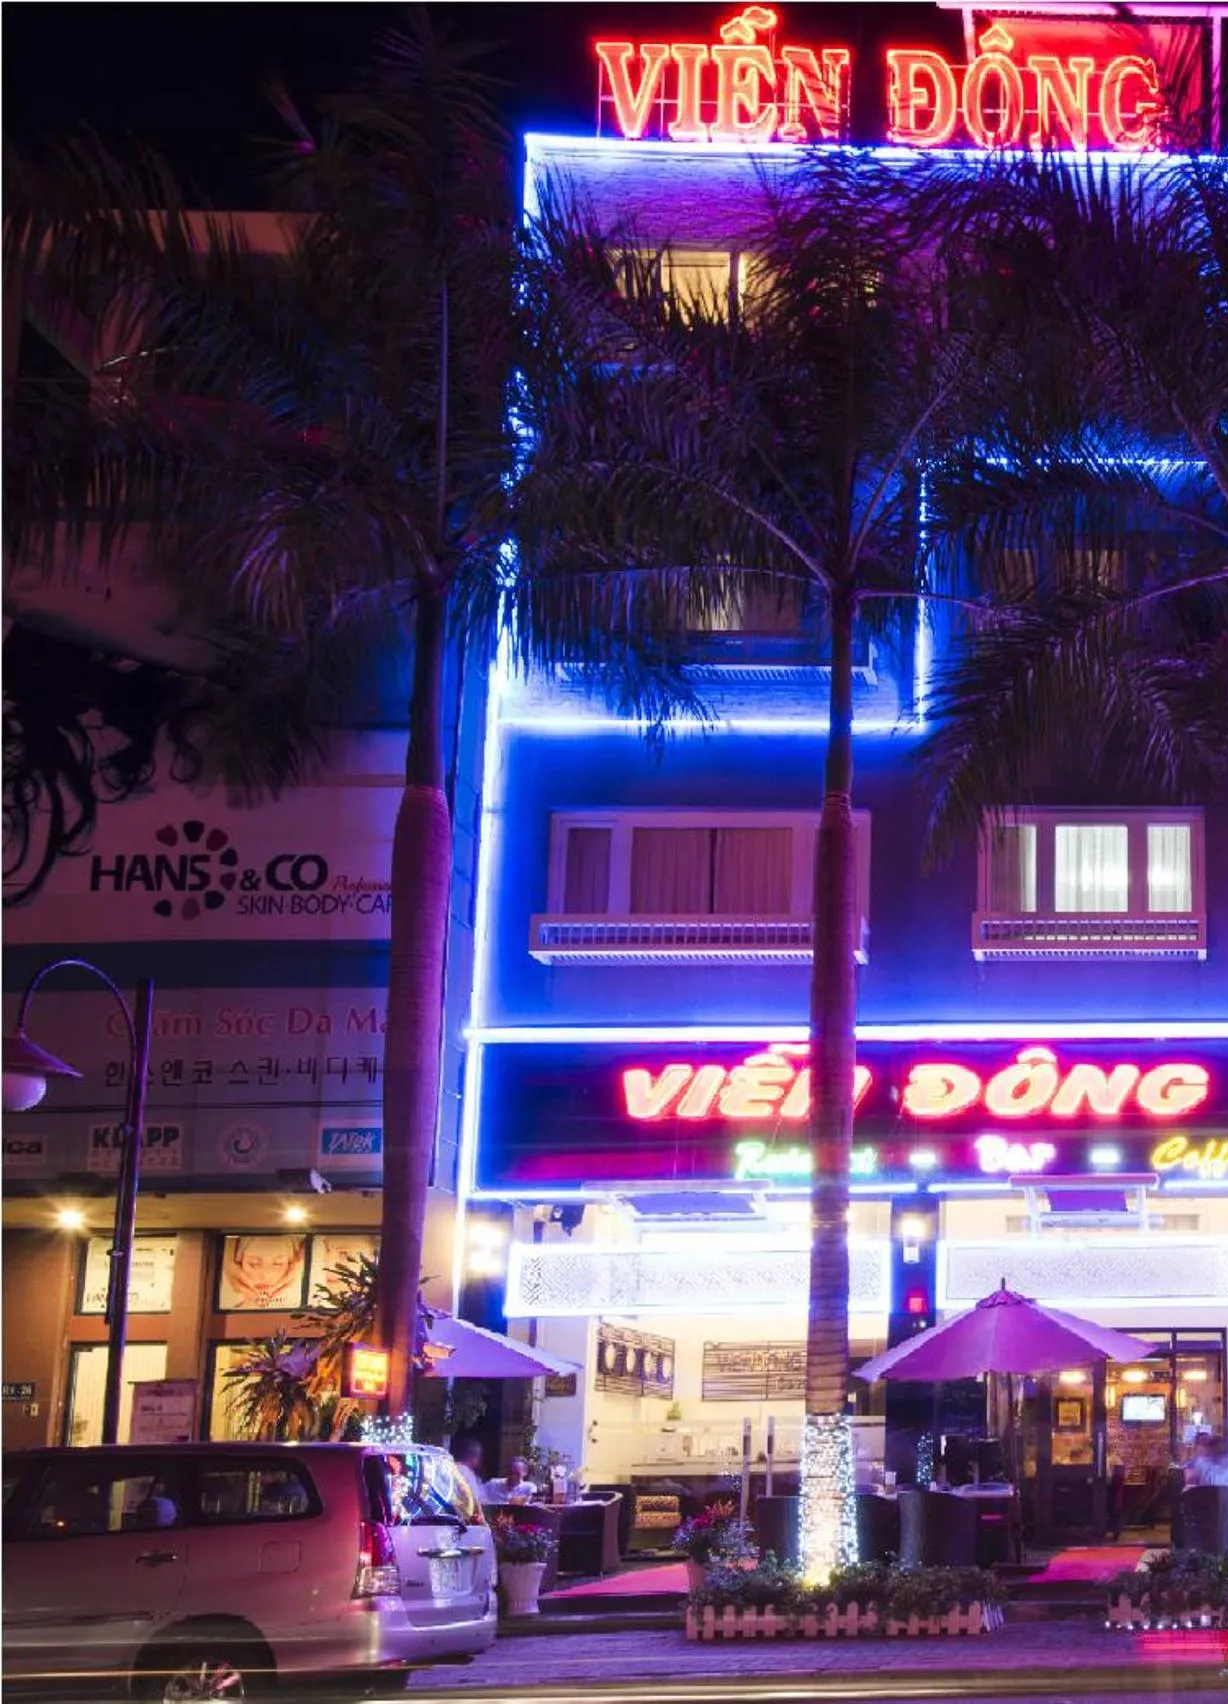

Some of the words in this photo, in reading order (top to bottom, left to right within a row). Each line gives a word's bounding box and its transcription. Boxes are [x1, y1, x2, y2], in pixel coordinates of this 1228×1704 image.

[90, 854, 211, 891] HANS
[265, 854, 328, 891] CO
[287, 1007, 331, 1035] Da
[904, 1048, 1209, 1117] ĐÔNG
[92, 1127, 179, 1148] KLPP
